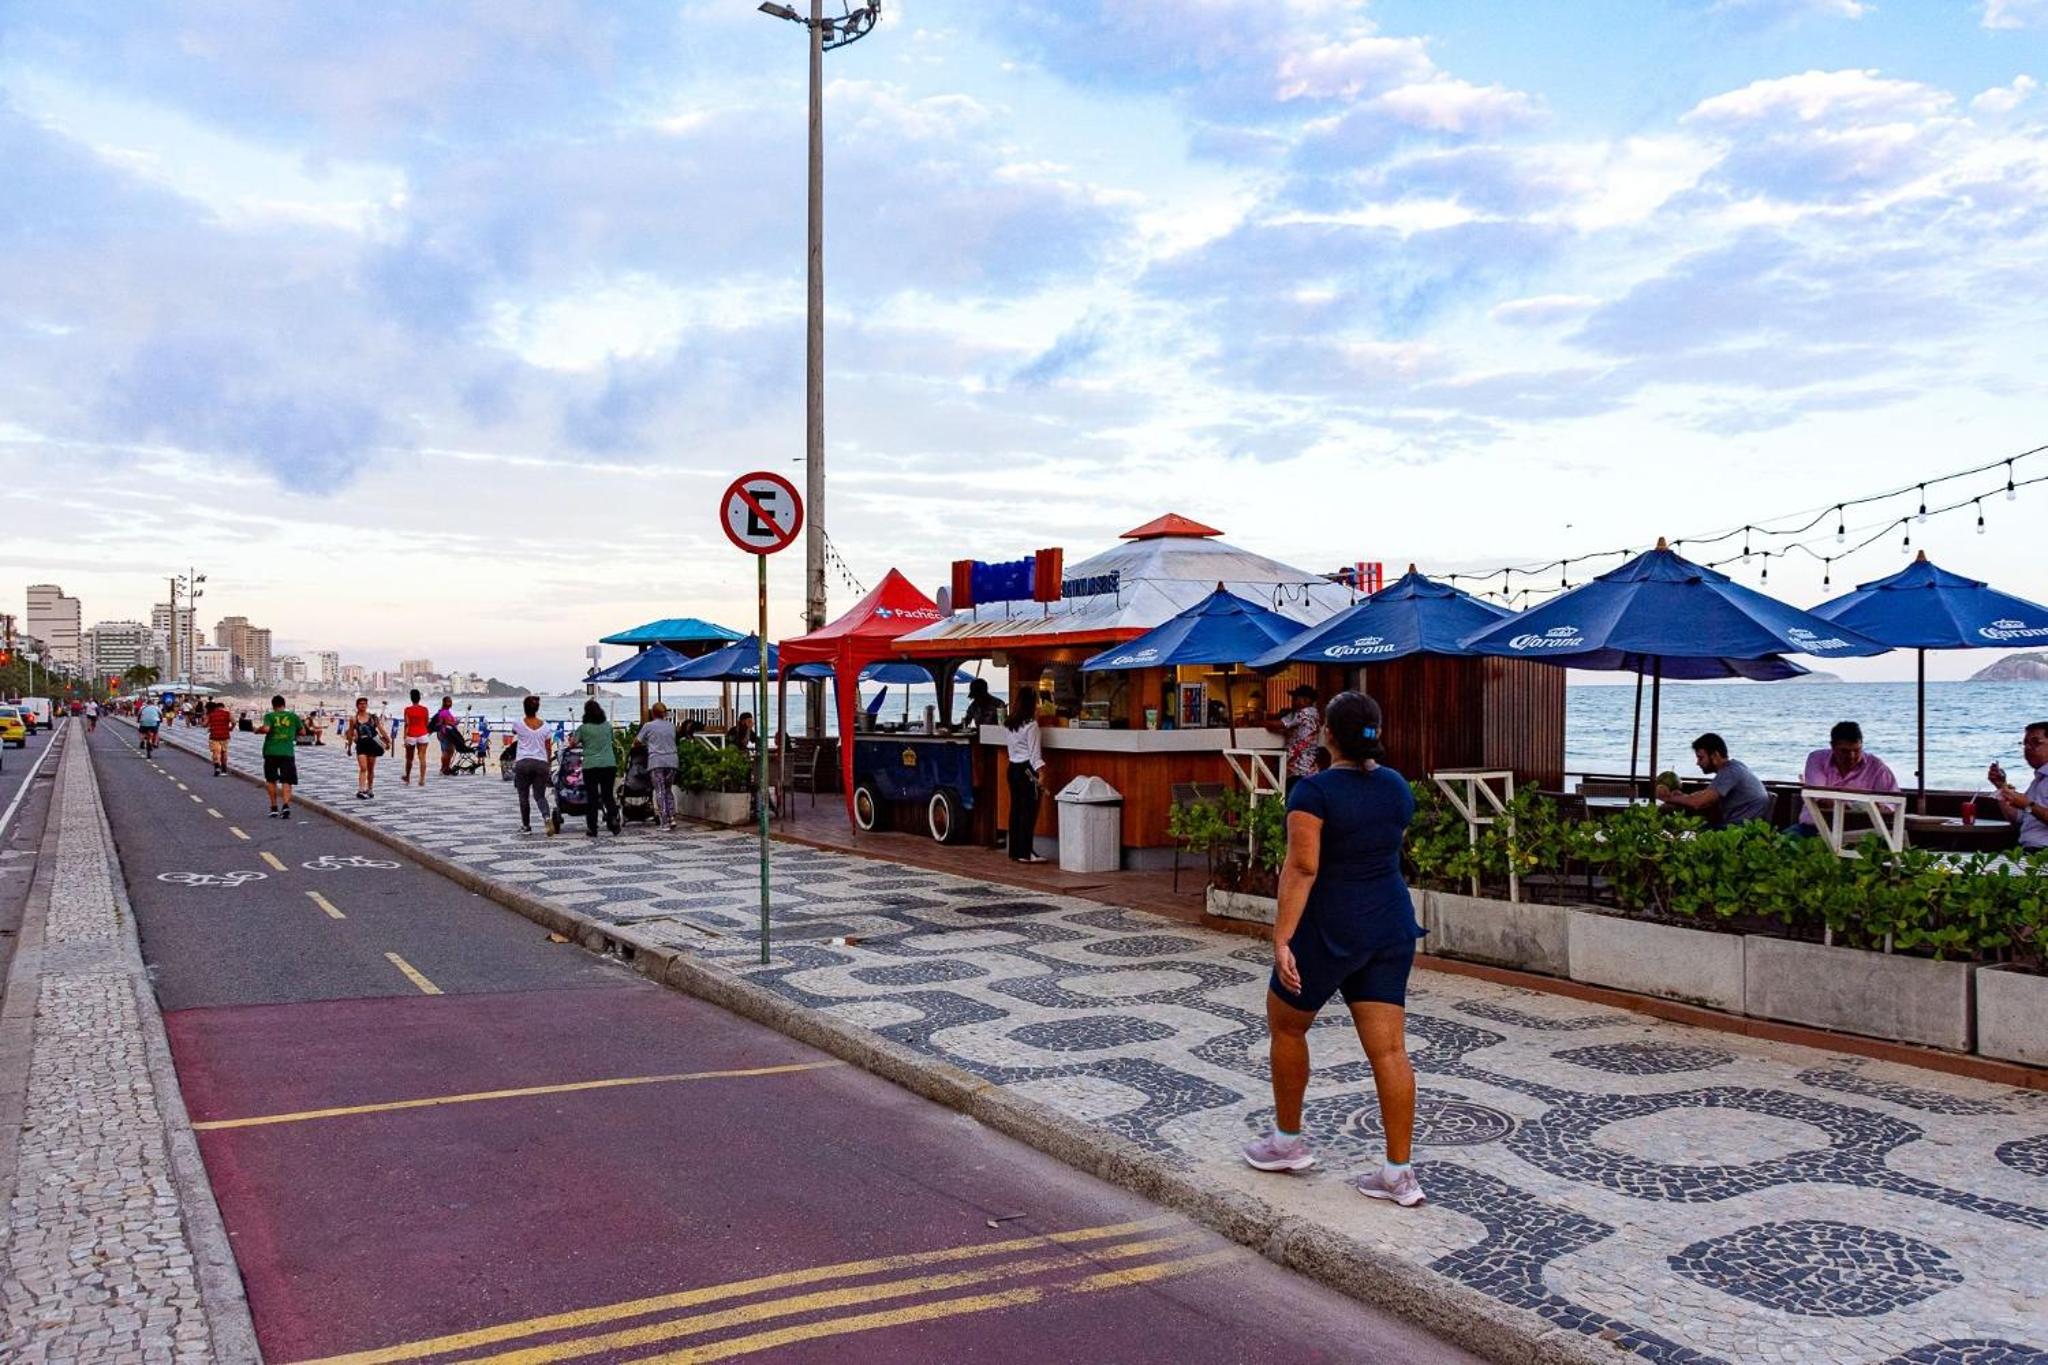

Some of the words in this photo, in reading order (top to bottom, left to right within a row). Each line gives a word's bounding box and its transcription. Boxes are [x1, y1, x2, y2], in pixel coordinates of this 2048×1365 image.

[747, 490, 776, 537] E
[1323, 643, 1395, 658] Corona
[1508, 634, 1584, 651] Corona
